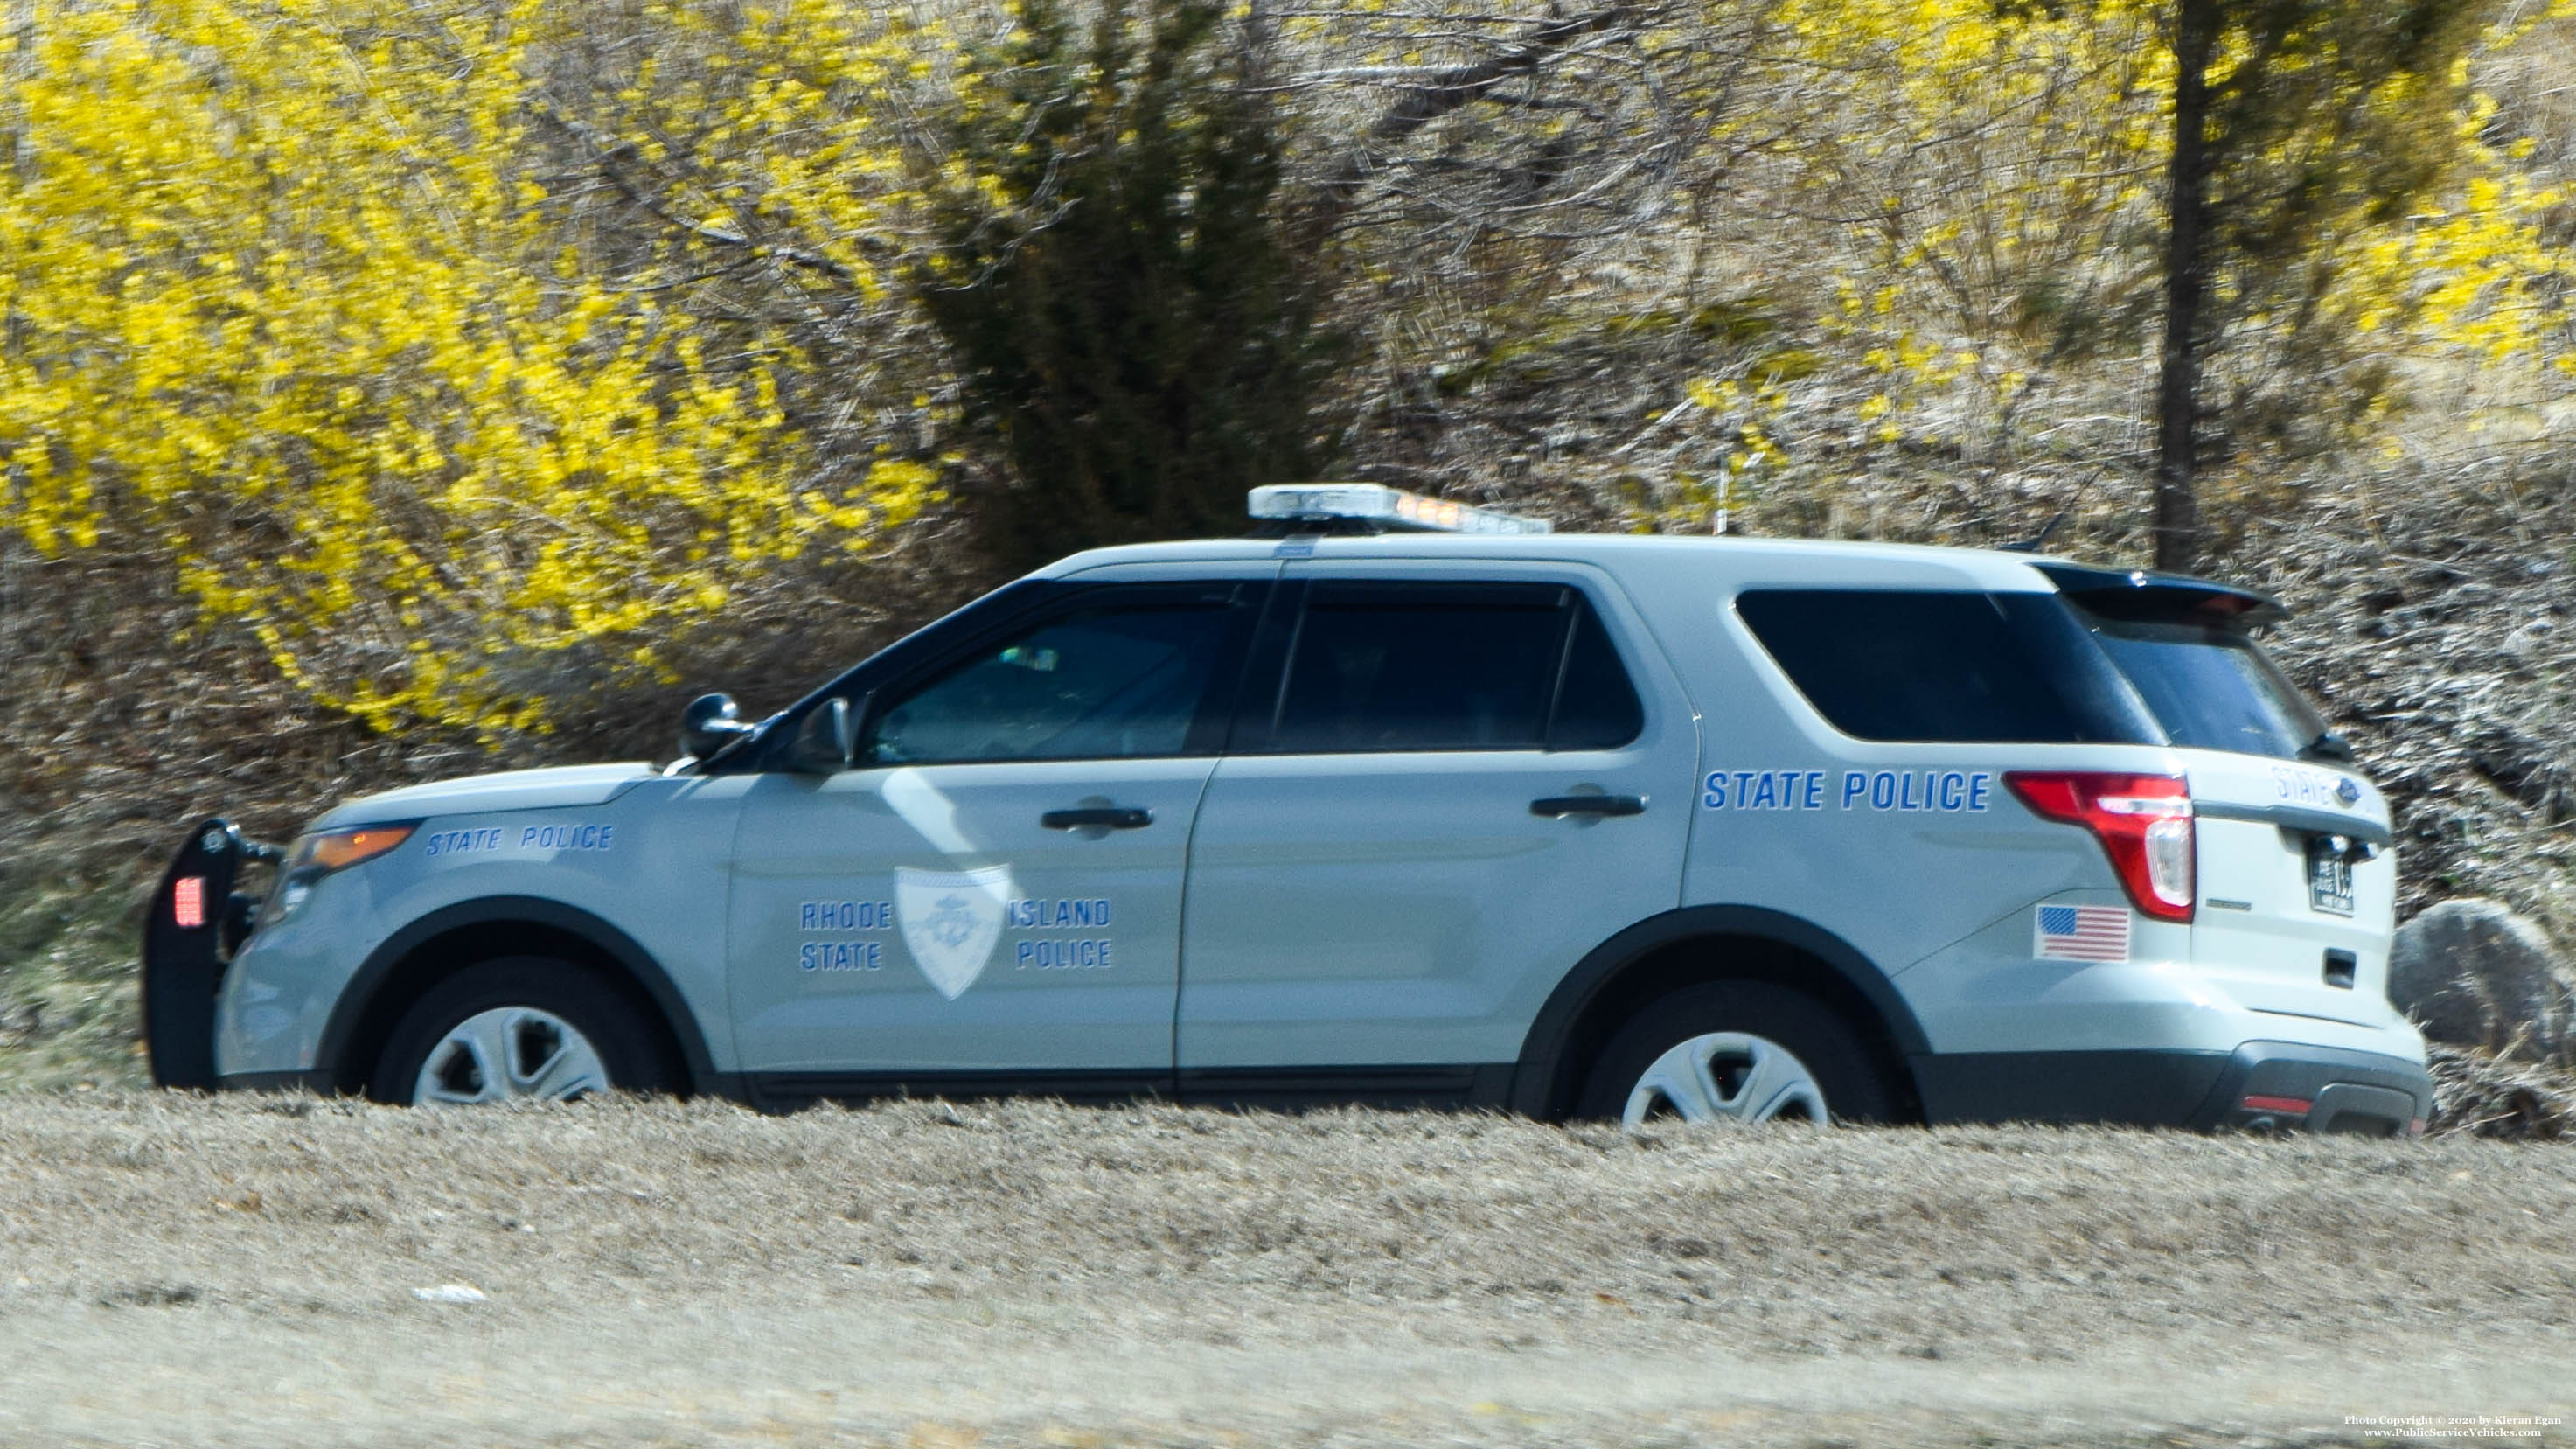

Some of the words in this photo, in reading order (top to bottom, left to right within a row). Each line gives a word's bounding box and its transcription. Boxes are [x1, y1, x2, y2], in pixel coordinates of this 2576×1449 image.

[1702, 770, 1827, 811] STATE
[1841, 770, 1991, 812] POLICE
[427, 827, 503, 857] STATE
[520, 825, 614, 851] POLICE
[799, 900, 894, 931] RHODE
[1007, 898, 1112, 930] ISLAND
[799, 942, 883, 972] STATE
[1014, 938, 1113, 970] POLICE
